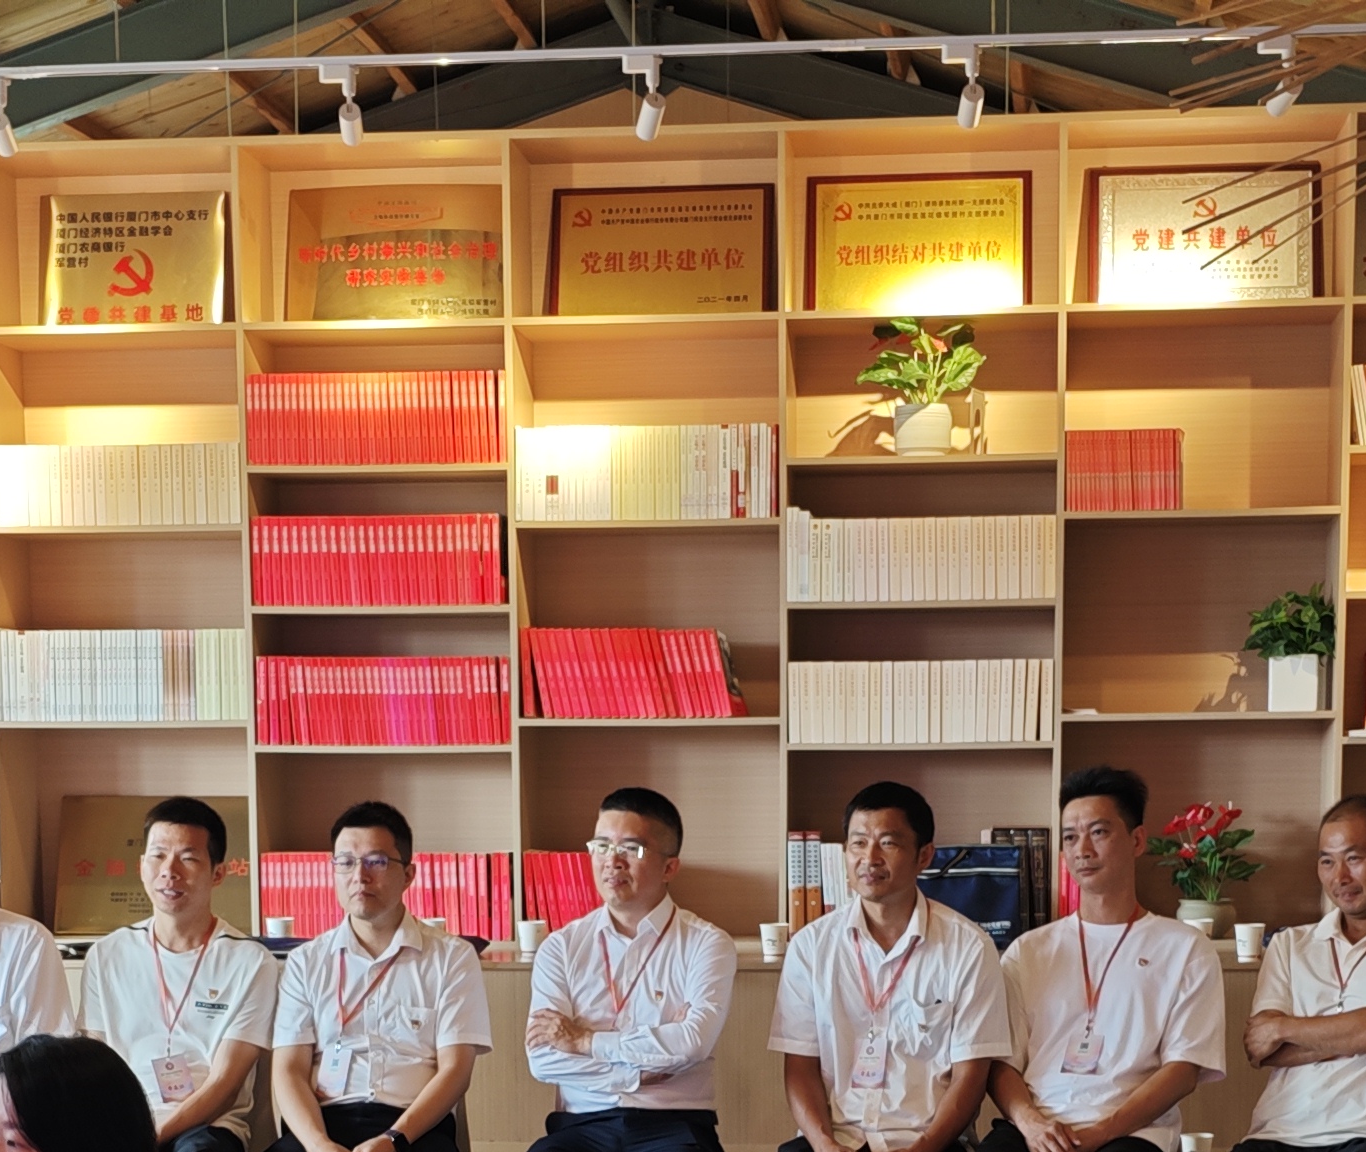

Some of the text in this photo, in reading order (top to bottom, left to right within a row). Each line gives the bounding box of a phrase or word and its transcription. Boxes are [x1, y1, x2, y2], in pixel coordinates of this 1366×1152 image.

[56, 209, 209, 224] 中国人民银行厦门市中心支行
[55, 225, 173, 239] 厦门经济特区金融学会
[55, 241, 126, 254] 厦门农商银行
[836, 240, 1002, 267] 党组织结对共建单位
[580, 247, 745, 275] 党组织共建单位
